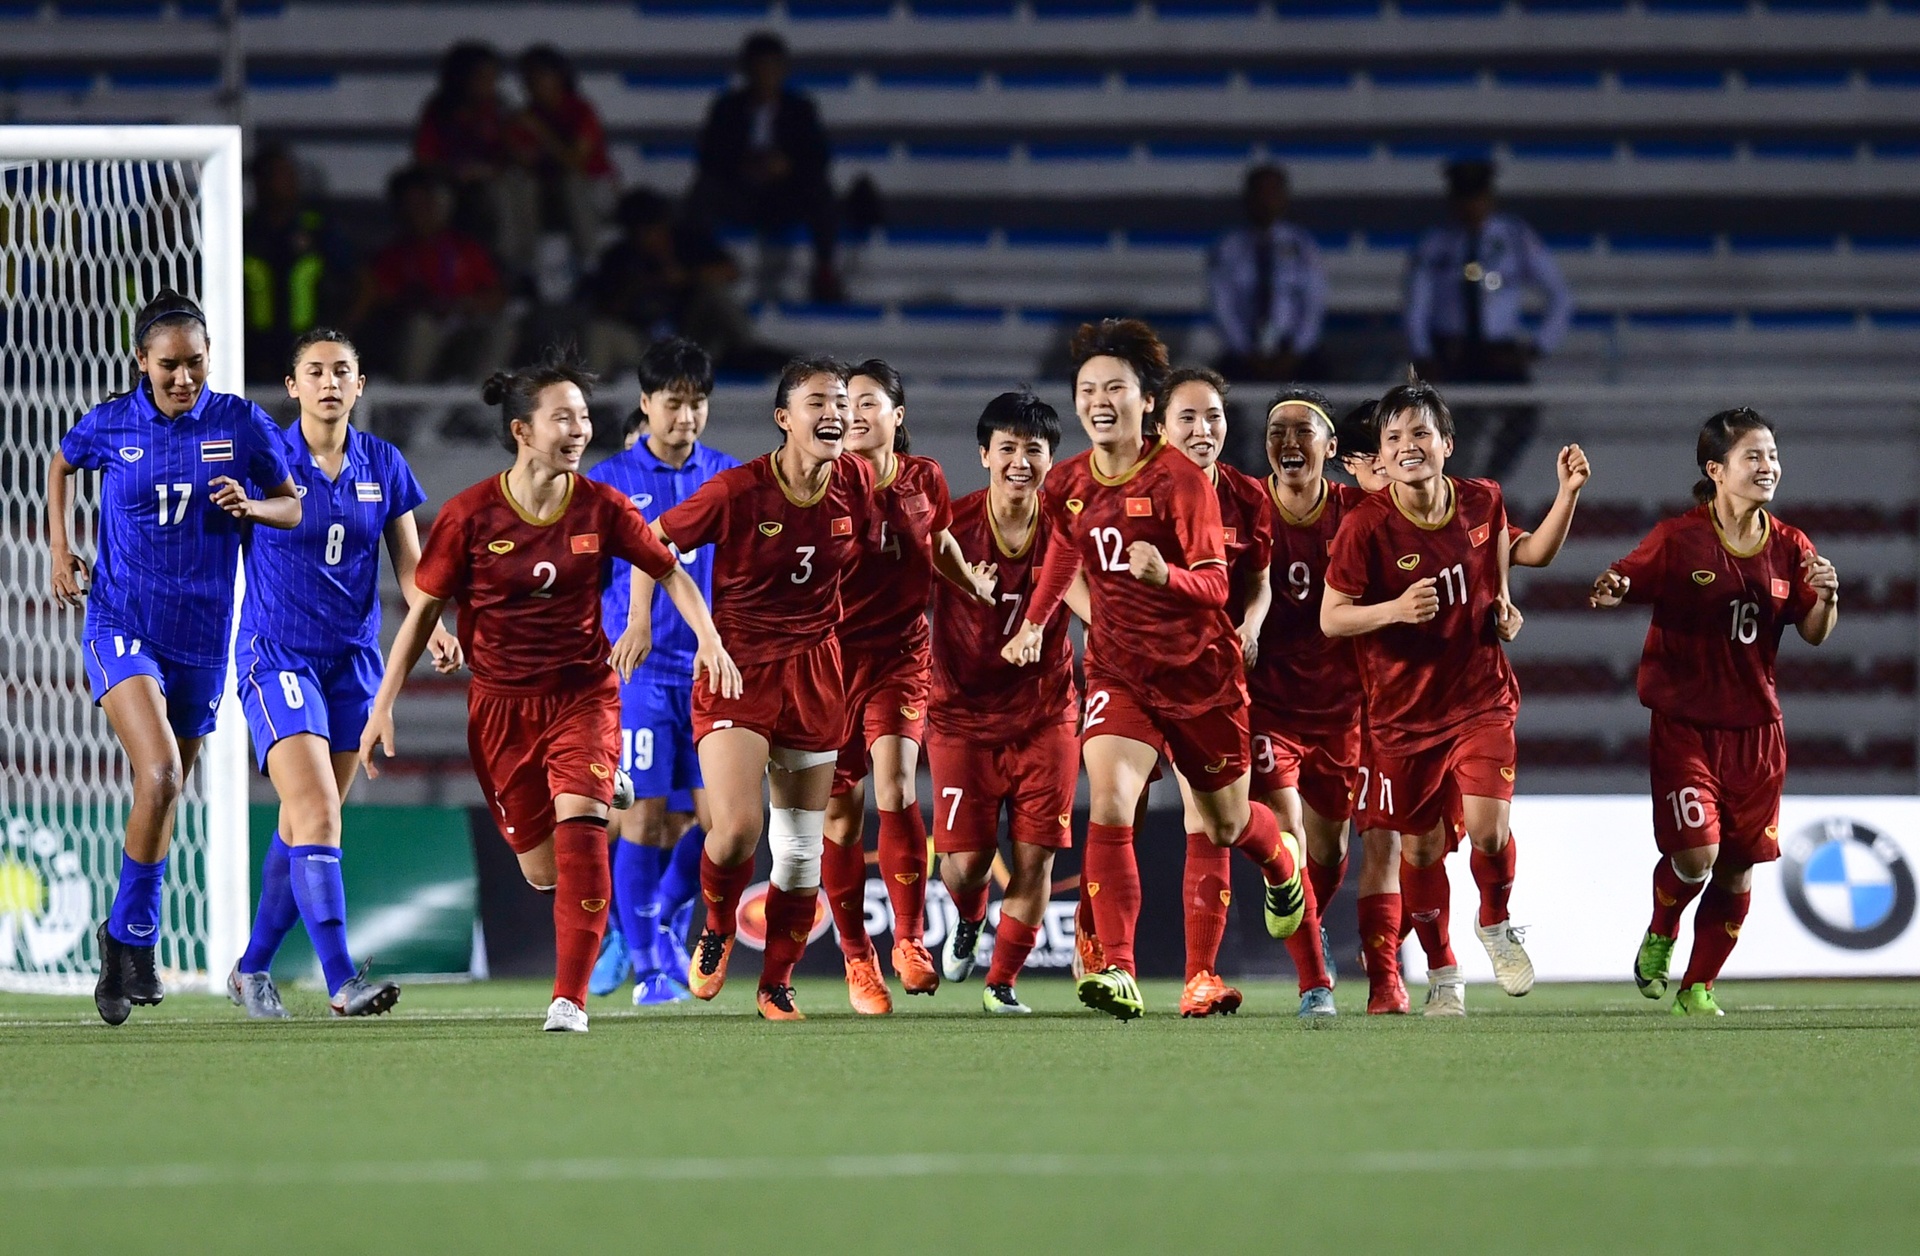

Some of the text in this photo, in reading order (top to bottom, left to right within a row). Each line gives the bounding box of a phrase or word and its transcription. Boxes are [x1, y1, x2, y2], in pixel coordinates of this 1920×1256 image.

[155, 483, 192, 526] 17
[324, 524, 345, 565] 8
[880, 520, 901, 561] 4
[1090, 527, 1130, 571] 12
[532, 561, 557, 598] 2
[791, 546, 815, 584] 3
[1288, 561, 1310, 600] 9
[1439, 563, 1467, 605] 11
[1001, 593, 1022, 635] 7
[1729, 599, 1760, 644] 16
[279, 671, 304, 709] 8
[622, 727, 654, 772] 19
[1252, 734, 1275, 774] 9
[942, 787, 963, 831] 7
[1379, 772, 1394, 815] 11
[1666, 787, 1706, 832] 16
